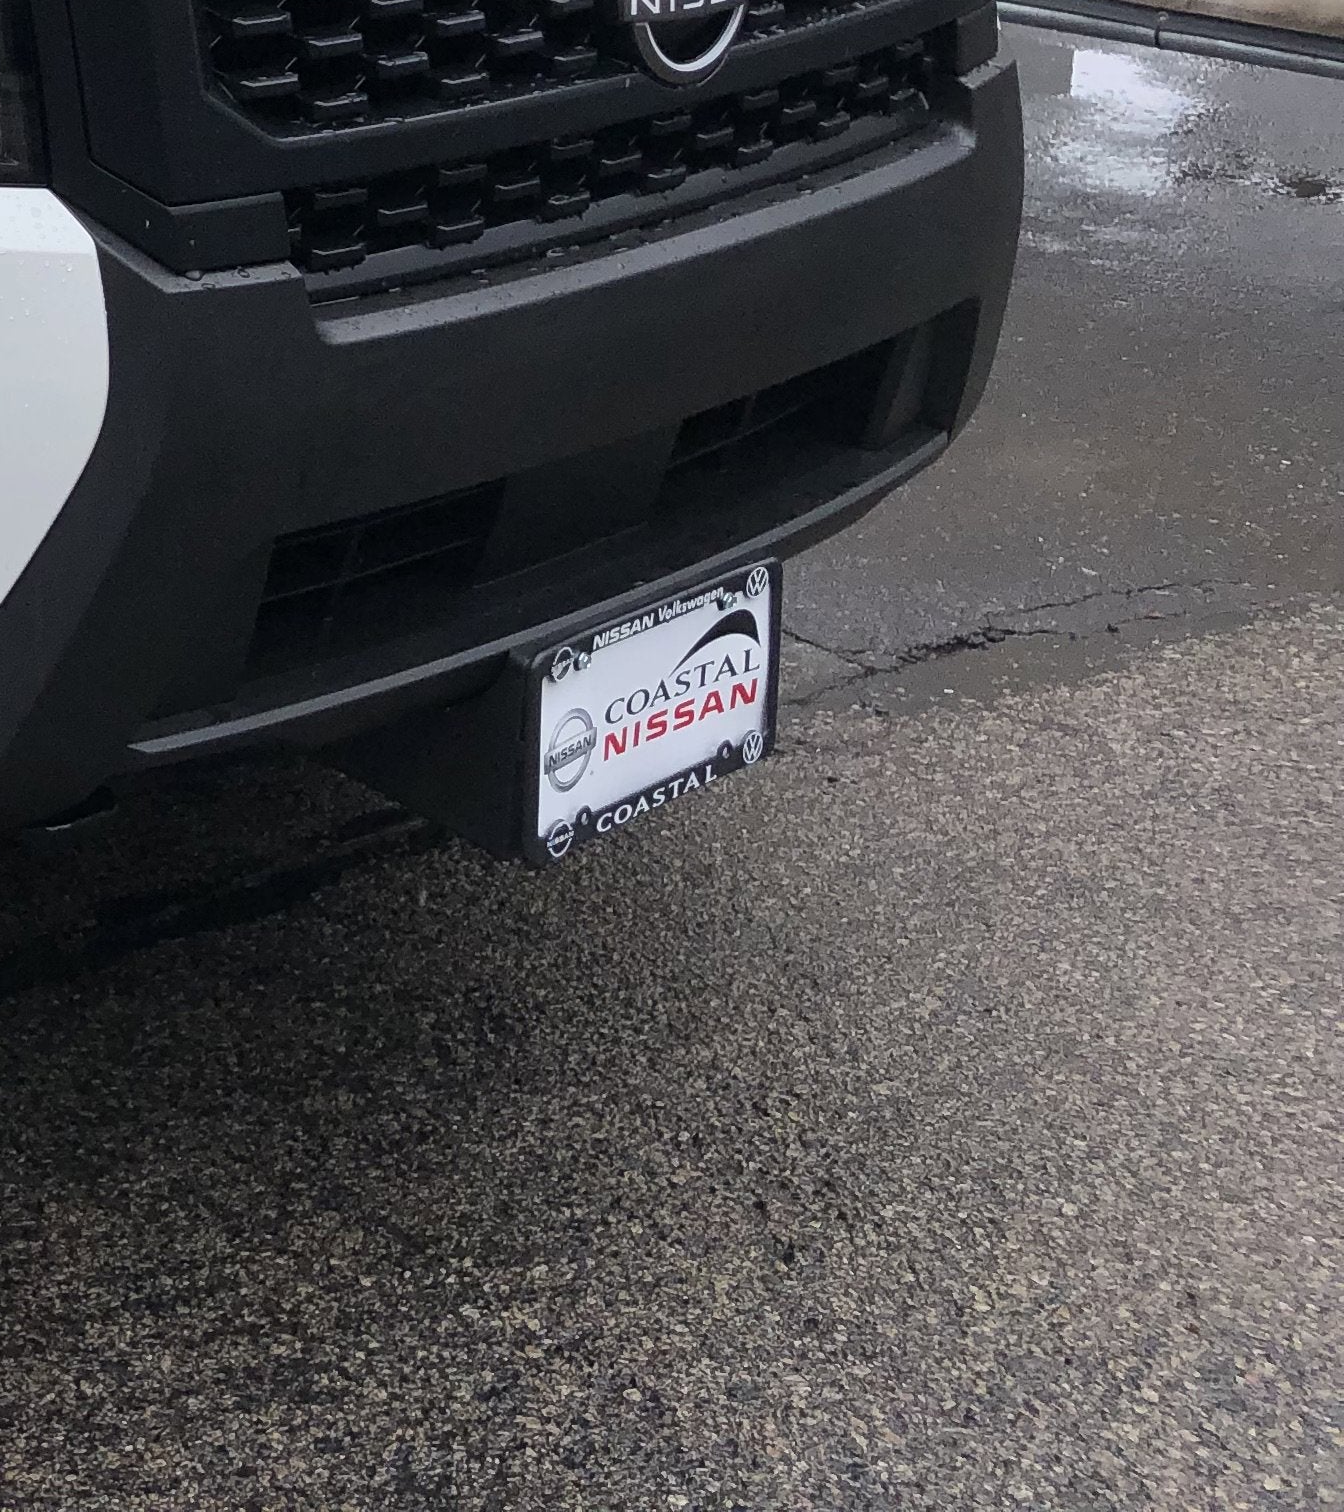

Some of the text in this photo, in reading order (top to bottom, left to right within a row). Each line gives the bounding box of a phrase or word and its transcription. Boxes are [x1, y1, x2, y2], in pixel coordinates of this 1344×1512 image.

[592, 586, 725, 650] NISSAN Volkswagen
[603, 678, 759, 762] NISSAN
[604, 648, 760, 725] COASTAL
[548, 734, 592, 768] NISSAN
[596, 765, 717, 833] COASTAL
